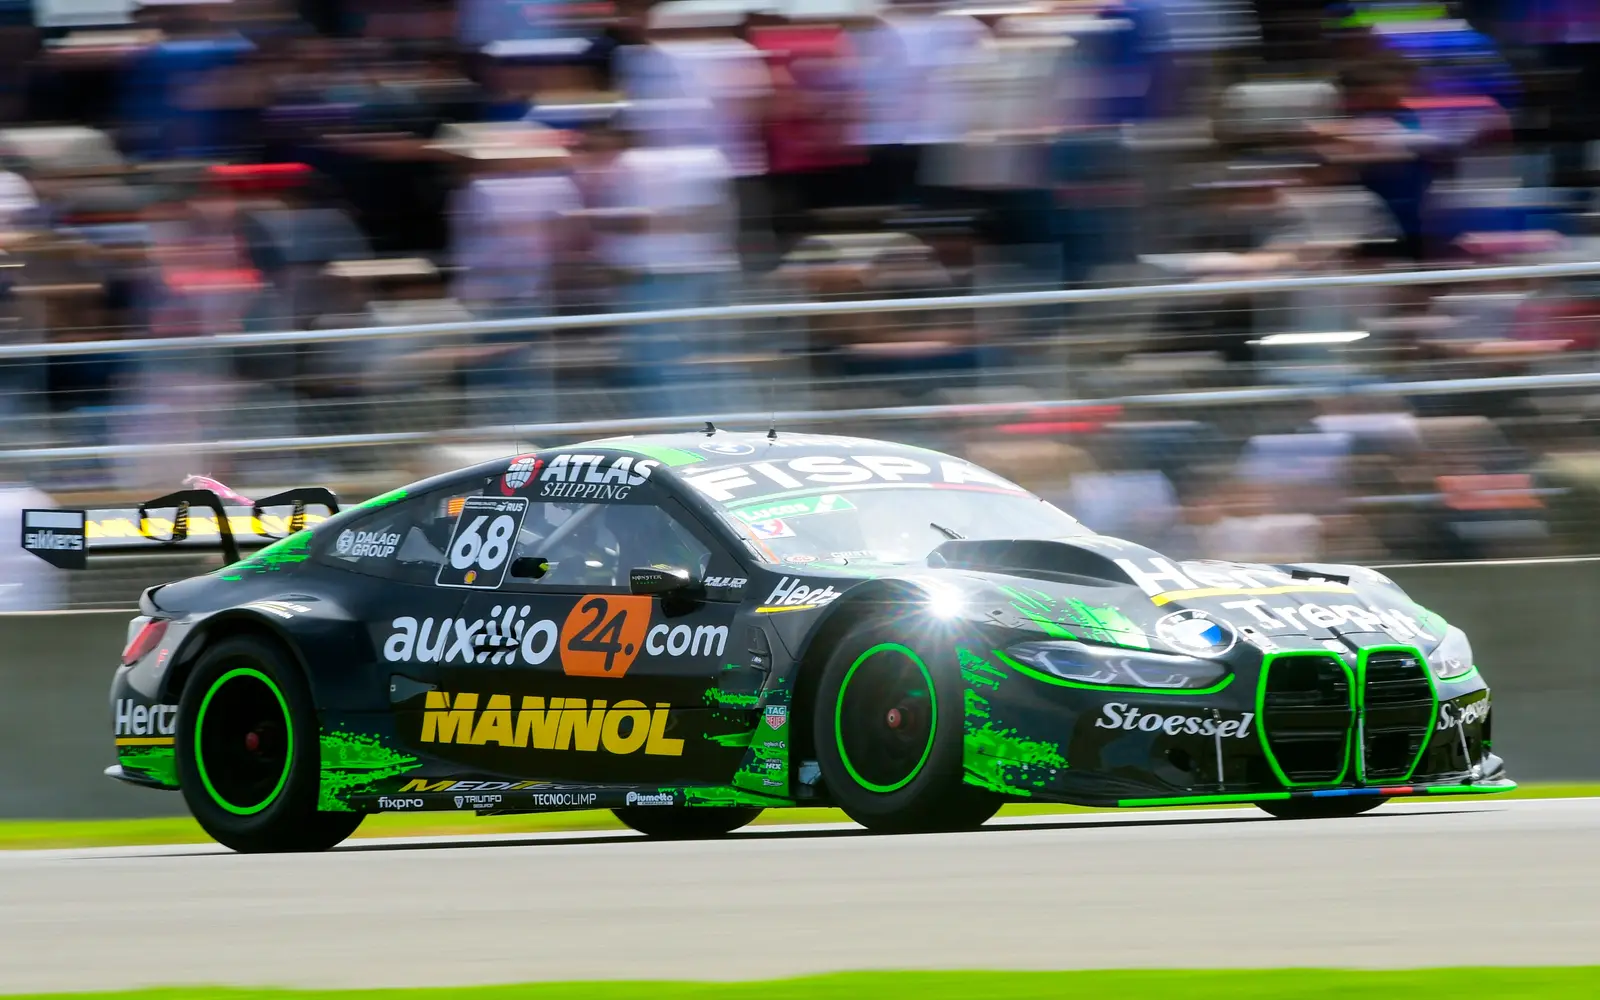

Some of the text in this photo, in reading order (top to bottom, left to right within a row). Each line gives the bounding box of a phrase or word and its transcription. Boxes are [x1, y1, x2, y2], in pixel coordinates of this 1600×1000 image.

[539, 454, 661, 486] ATLAS
[681, 456, 1027, 502] FISPA
[540, 482, 632, 500] SHIPPING
[506, 502, 524, 512] RUS
[355, 531, 401, 546] DALAGI
[450, 514, 515, 571] 68
[351, 544, 395, 558] GROUP
[763, 576, 843, 607] Hertz
[115, 698, 178, 736] Hertz
[767, 706, 785, 715] TAG
[420, 690, 685, 757] MANNOL
[1094, 702, 1255, 739] Stoessel
[378, 796, 424, 810] fixpro
[464, 794, 502, 803] TRIUNFO
[533, 793, 597, 806] TECNOCLIMP
[626, 791, 674, 806] Piumetto
